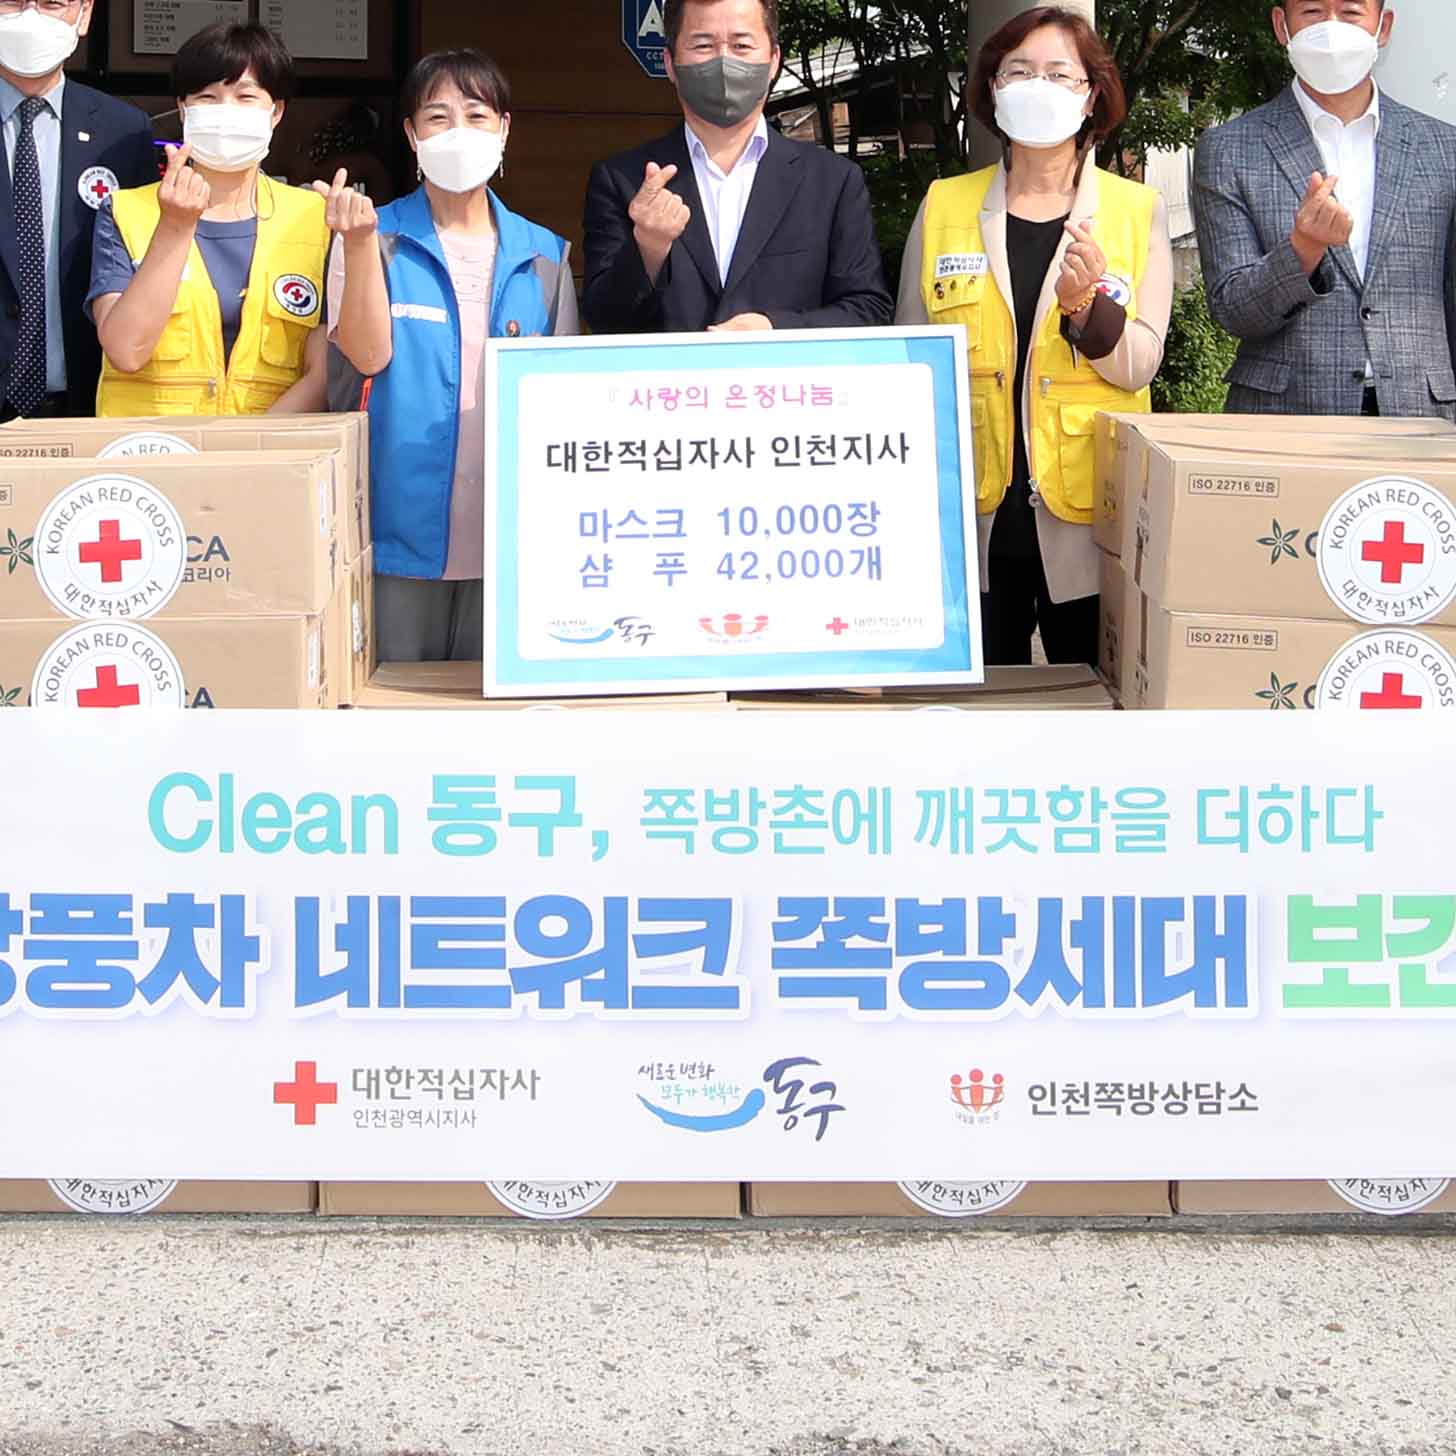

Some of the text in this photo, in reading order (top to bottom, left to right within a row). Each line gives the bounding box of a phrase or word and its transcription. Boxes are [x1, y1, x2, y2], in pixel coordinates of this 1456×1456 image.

[546, 432, 910, 475] 대한적십자사 인천지사
[1192, 479, 1276, 494] ISO 22716 인증
[46, 486, 175, 556] KOREAN RED CROSS
[579, 501, 882, 544] 마스크 10,000장
[1330, 489, 1382, 551] KOREAN
[1385, 487, 1421, 507] RED
[1422, 500, 1456, 556] CROSS
[579, 546, 883, 588] 샴 푸 42,000개
[63, 578, 164, 617] 대한적십자사
[1341, 578, 1440, 617] 대한적십자사
[614, 616, 655, 646] 동구
[1190, 633, 1274, 648] ISO 22716 인증
[45, 632, 173, 703] KOREAN RED CROSS
[1328, 640, 1455, 708] KOREAN RED CROSS
[146, 771, 1385, 863] Clean 동구, 쪽방촌에 깨끗함을 더하다
[292, 890, 748, 1014] 네트워크
[771, 893, 1251, 1012] 쪽방세대
[351, 1066, 542, 1104] 대한적십자사
[638, 1062, 716, 1081] 새로운 변화
[661, 1085, 696, 1101] 모두가
[764, 1056, 846, 1142] 동구
[1028, 1081, 1260, 1116] 인천쪽방상담소
[352, 1109, 478, 1130] 인천광역시지사
